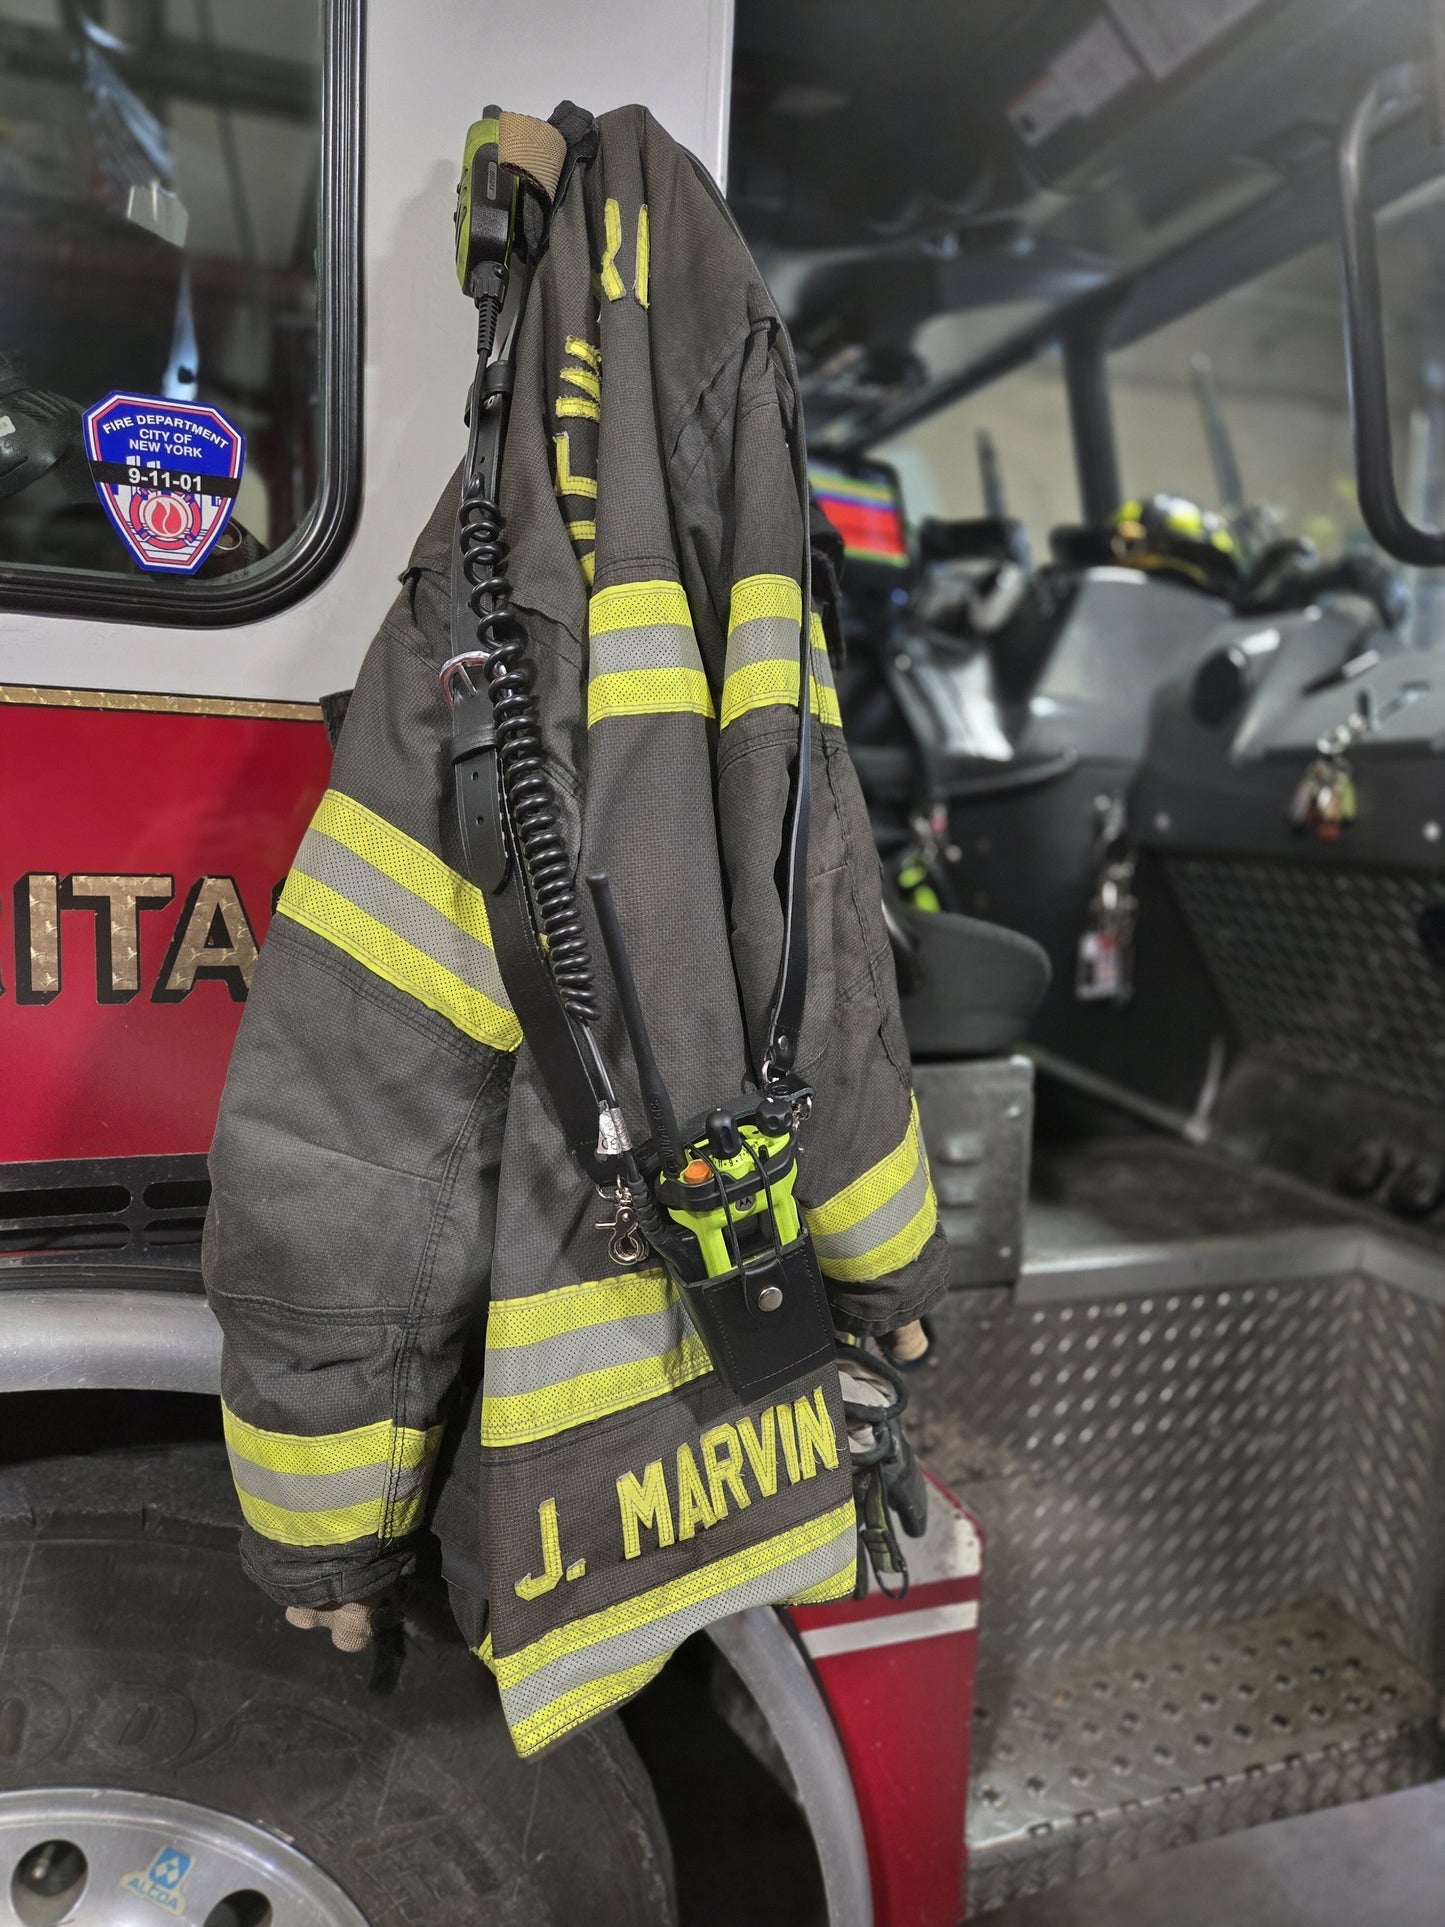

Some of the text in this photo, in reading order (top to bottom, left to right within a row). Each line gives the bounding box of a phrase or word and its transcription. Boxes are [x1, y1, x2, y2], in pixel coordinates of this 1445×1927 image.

[102, 415, 229, 449] FIRE DEPARTMENT
[139, 428, 193, 445] CITY OF
[129, 439, 203, 458] NEW YORK
[128, 467, 202, 492] 9-11-01
[0, 872, 285, 1005] ITA
[650, 1099, 662, 1119] GPS
[513, 1385, 840, 1601] J. MARVIN
